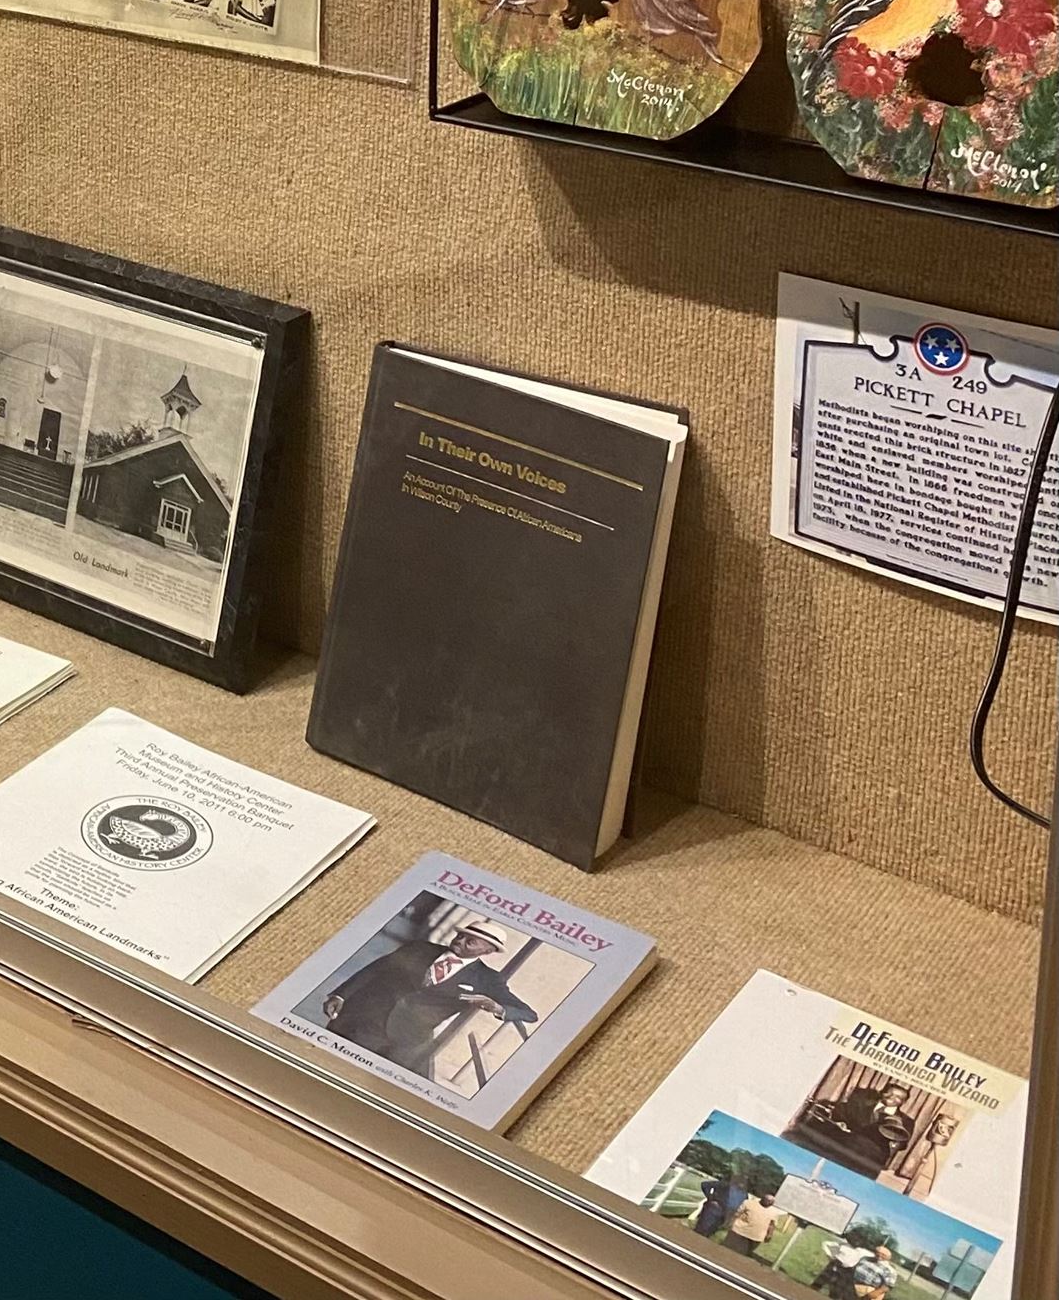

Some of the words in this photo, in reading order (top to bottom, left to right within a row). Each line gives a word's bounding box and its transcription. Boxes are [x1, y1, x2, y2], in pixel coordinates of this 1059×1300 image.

[854, 377, 935, 407] PICKETT
[947, 398, 1027, 428] CHAPEL
[952, 376, 987, 394] 249
[817, 421, 841, 432] gants
[843, 428, 881, 442] erected
[885, 437, 903, 448] this
[907, 442, 932, 455] brick
[935, 450, 986, 468] structure
[989, 462, 1000, 471] in
[1003, 465, 1026, 477] 1827
[818, 410, 842, 421] after
[846, 417, 899, 437] purchasing
[903, 431, 915, 440] an
[919, 435, 960, 450] original
[964, 445, 989, 457] town
[994, 451, 1011, 463] lot.
[819, 399, 869, 417] Methodists
[872, 412, 901, 425] began
[904, 421, 959, 440] worshiping
[963, 435, 975, 443] on
[978, 437, 998, 448] this
[1002, 443, 1022, 453] site
[419, 431, 434, 449] In
[437, 437, 477, 462] Their
[478, 452, 513, 476] Own
[516, 464, 566, 494] Voices
[401, 483, 410, 493] In
[410, 486, 435, 503] Wilson
[435, 494, 462, 514] County
[403, 471, 415, 482] An
[413, 475, 444, 492] Account
[456, 487, 469, 502] The
[468, 494, 505, 515] Presence
[513, 509, 540, 528] African
[539, 520, 582, 543] Americans
[73, 550, 89, 564] Old
[91, 557, 129, 578] Landmark
[115, 747, 142, 764] Third
[140, 760, 179, 782] Annual
[178, 777, 246, 811] Preservation
[247, 807, 295, 830] Banquet
[139, 749, 183, 774] Museum
[184, 773, 207, 784] and
[206, 781, 245, 800] History
[246, 797, 285, 816] Center
[146, 743, 168, 757] Roy
[168, 754, 202, 772] Bailey
[201, 770, 293, 810] African-American
[152, 778, 179, 792] June
[198, 798, 226, 812] 2011
[228, 810, 254, 824] 6:00
[252, 821, 272, 832] pm
[161, 801, 181, 811] ROY
[120, 859, 167, 868] HISTORY
[169, 847, 204, 866] CENTER
[5, 883, 44, 905] African
[44, 903, 98, 931] American
[39, 886, 80, 912] Theme:
[437, 870, 531, 917] DeFord
[534, 909, 614, 951] Bailey
[280, 1017, 316, 1037] David
[332, 1042, 374, 1067] Morton
[375, 1065, 394, 1077] with
[394, 1073, 423, 1092] Charles
